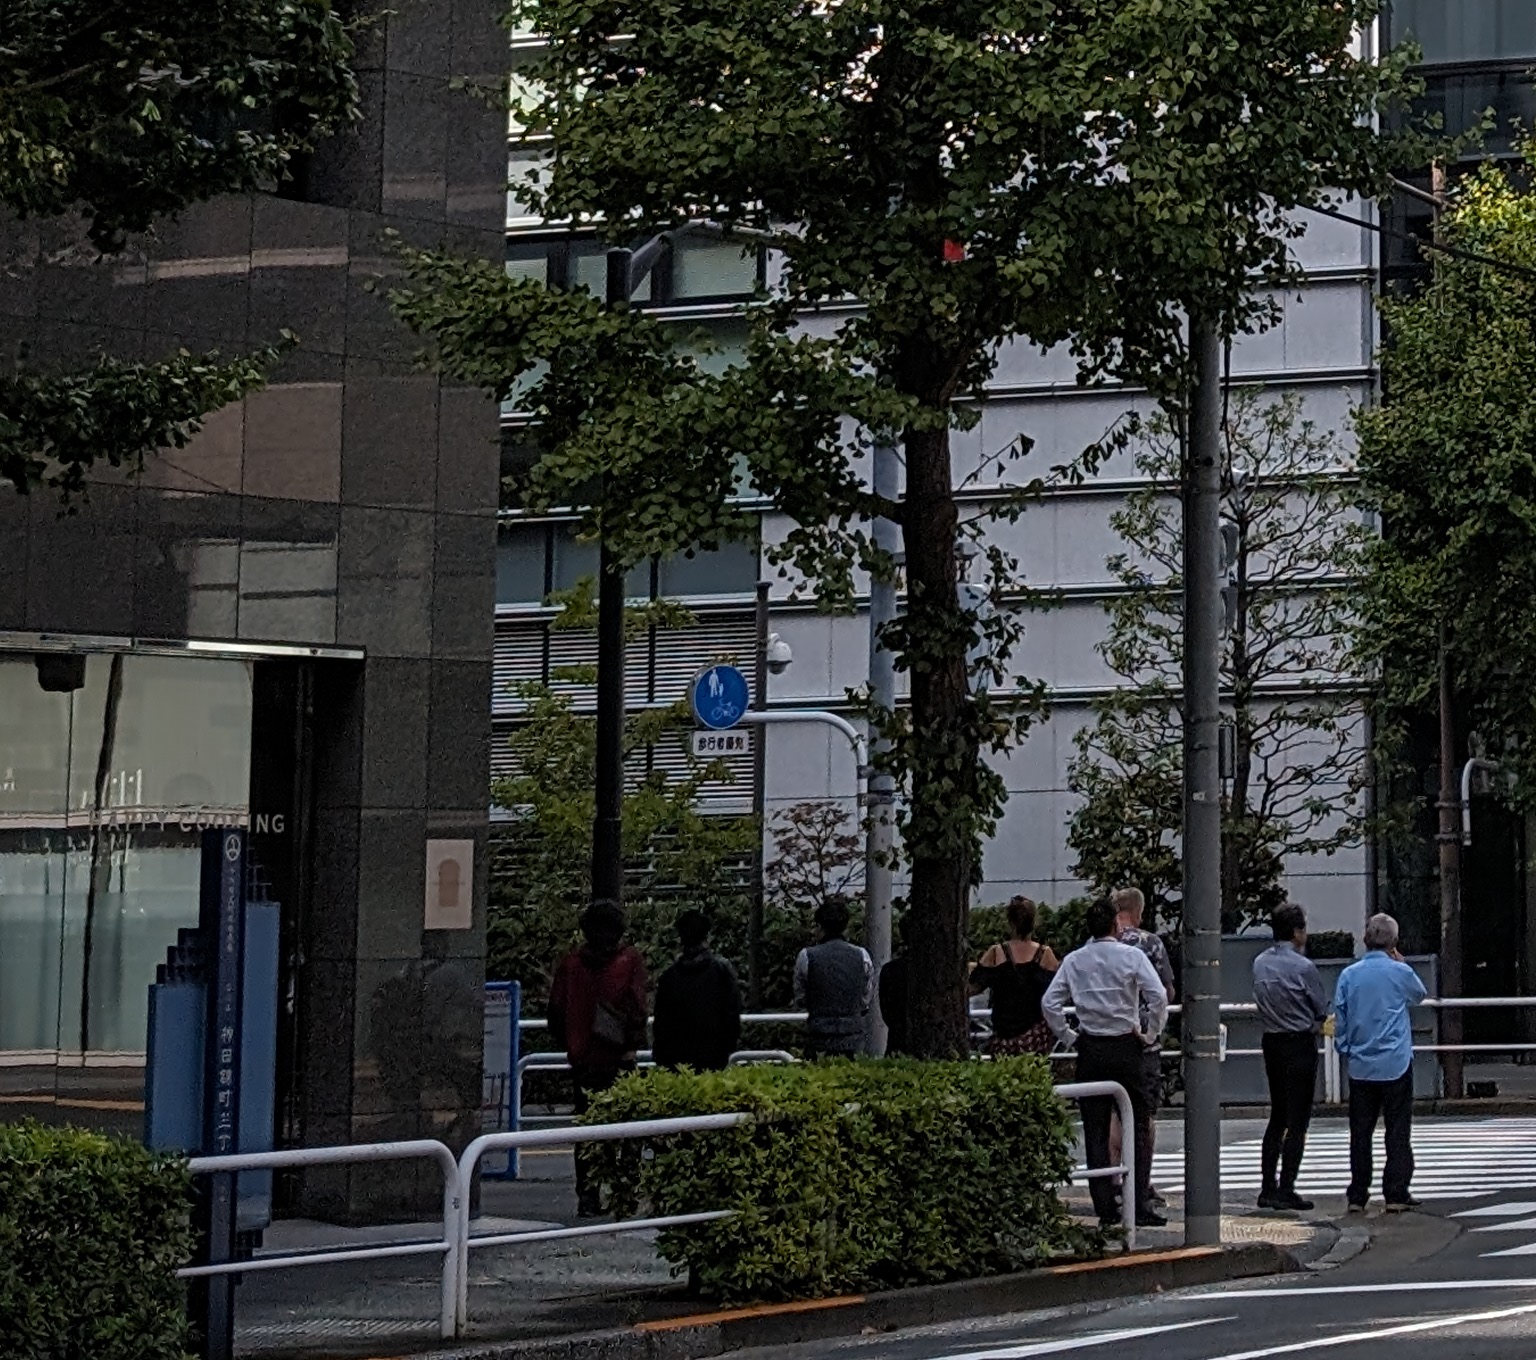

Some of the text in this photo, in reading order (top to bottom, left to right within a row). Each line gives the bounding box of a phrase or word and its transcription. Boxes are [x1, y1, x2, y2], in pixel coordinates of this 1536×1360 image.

[217, 1026, 234, 1152] 神田錦町三丁
